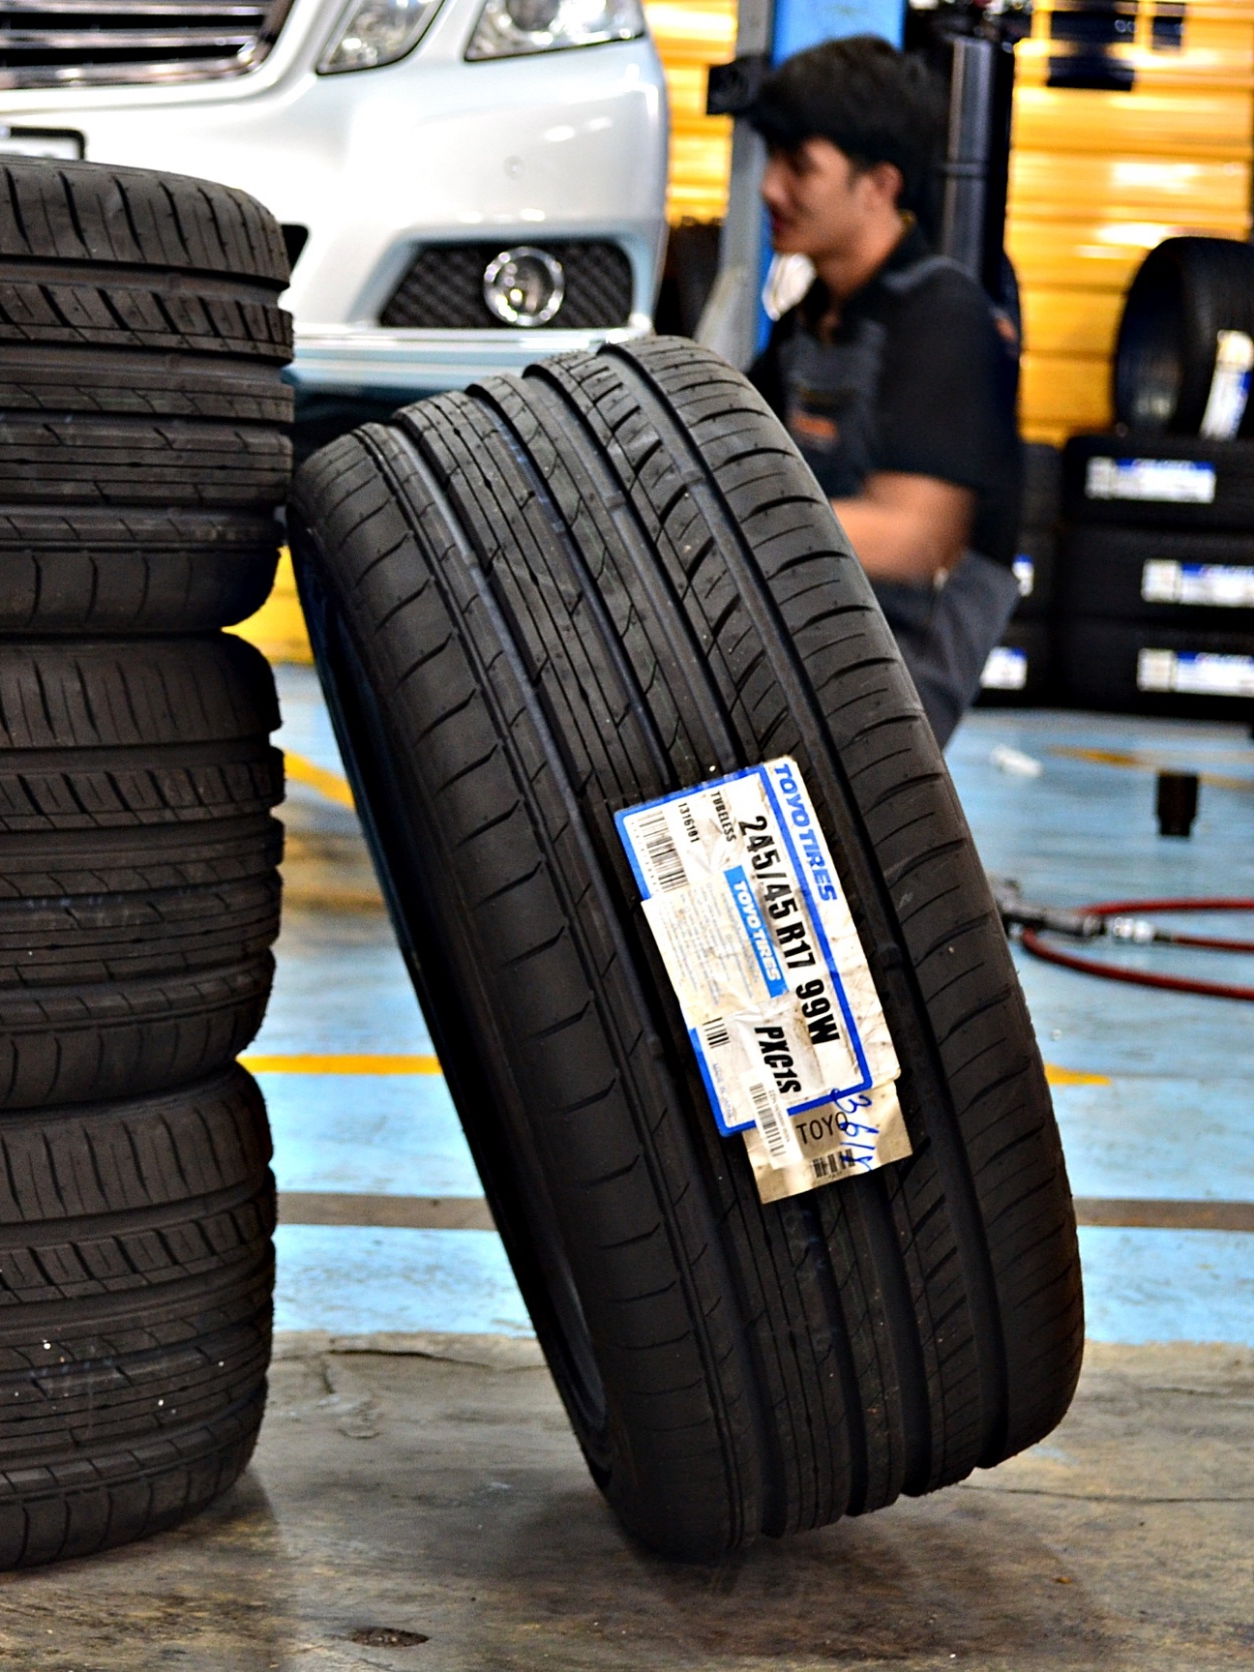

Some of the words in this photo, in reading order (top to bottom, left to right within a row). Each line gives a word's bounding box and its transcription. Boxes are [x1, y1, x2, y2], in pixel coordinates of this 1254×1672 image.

[710, 791, 737, 843] TUBELESS
[739, 815, 799, 920] 245/45
[775, 921, 816, 970] R17
[795, 978, 841, 1046] 99W
[754, 1026, 802, 1095] PXC1S
[795, 1111, 849, 1145] TOYO
